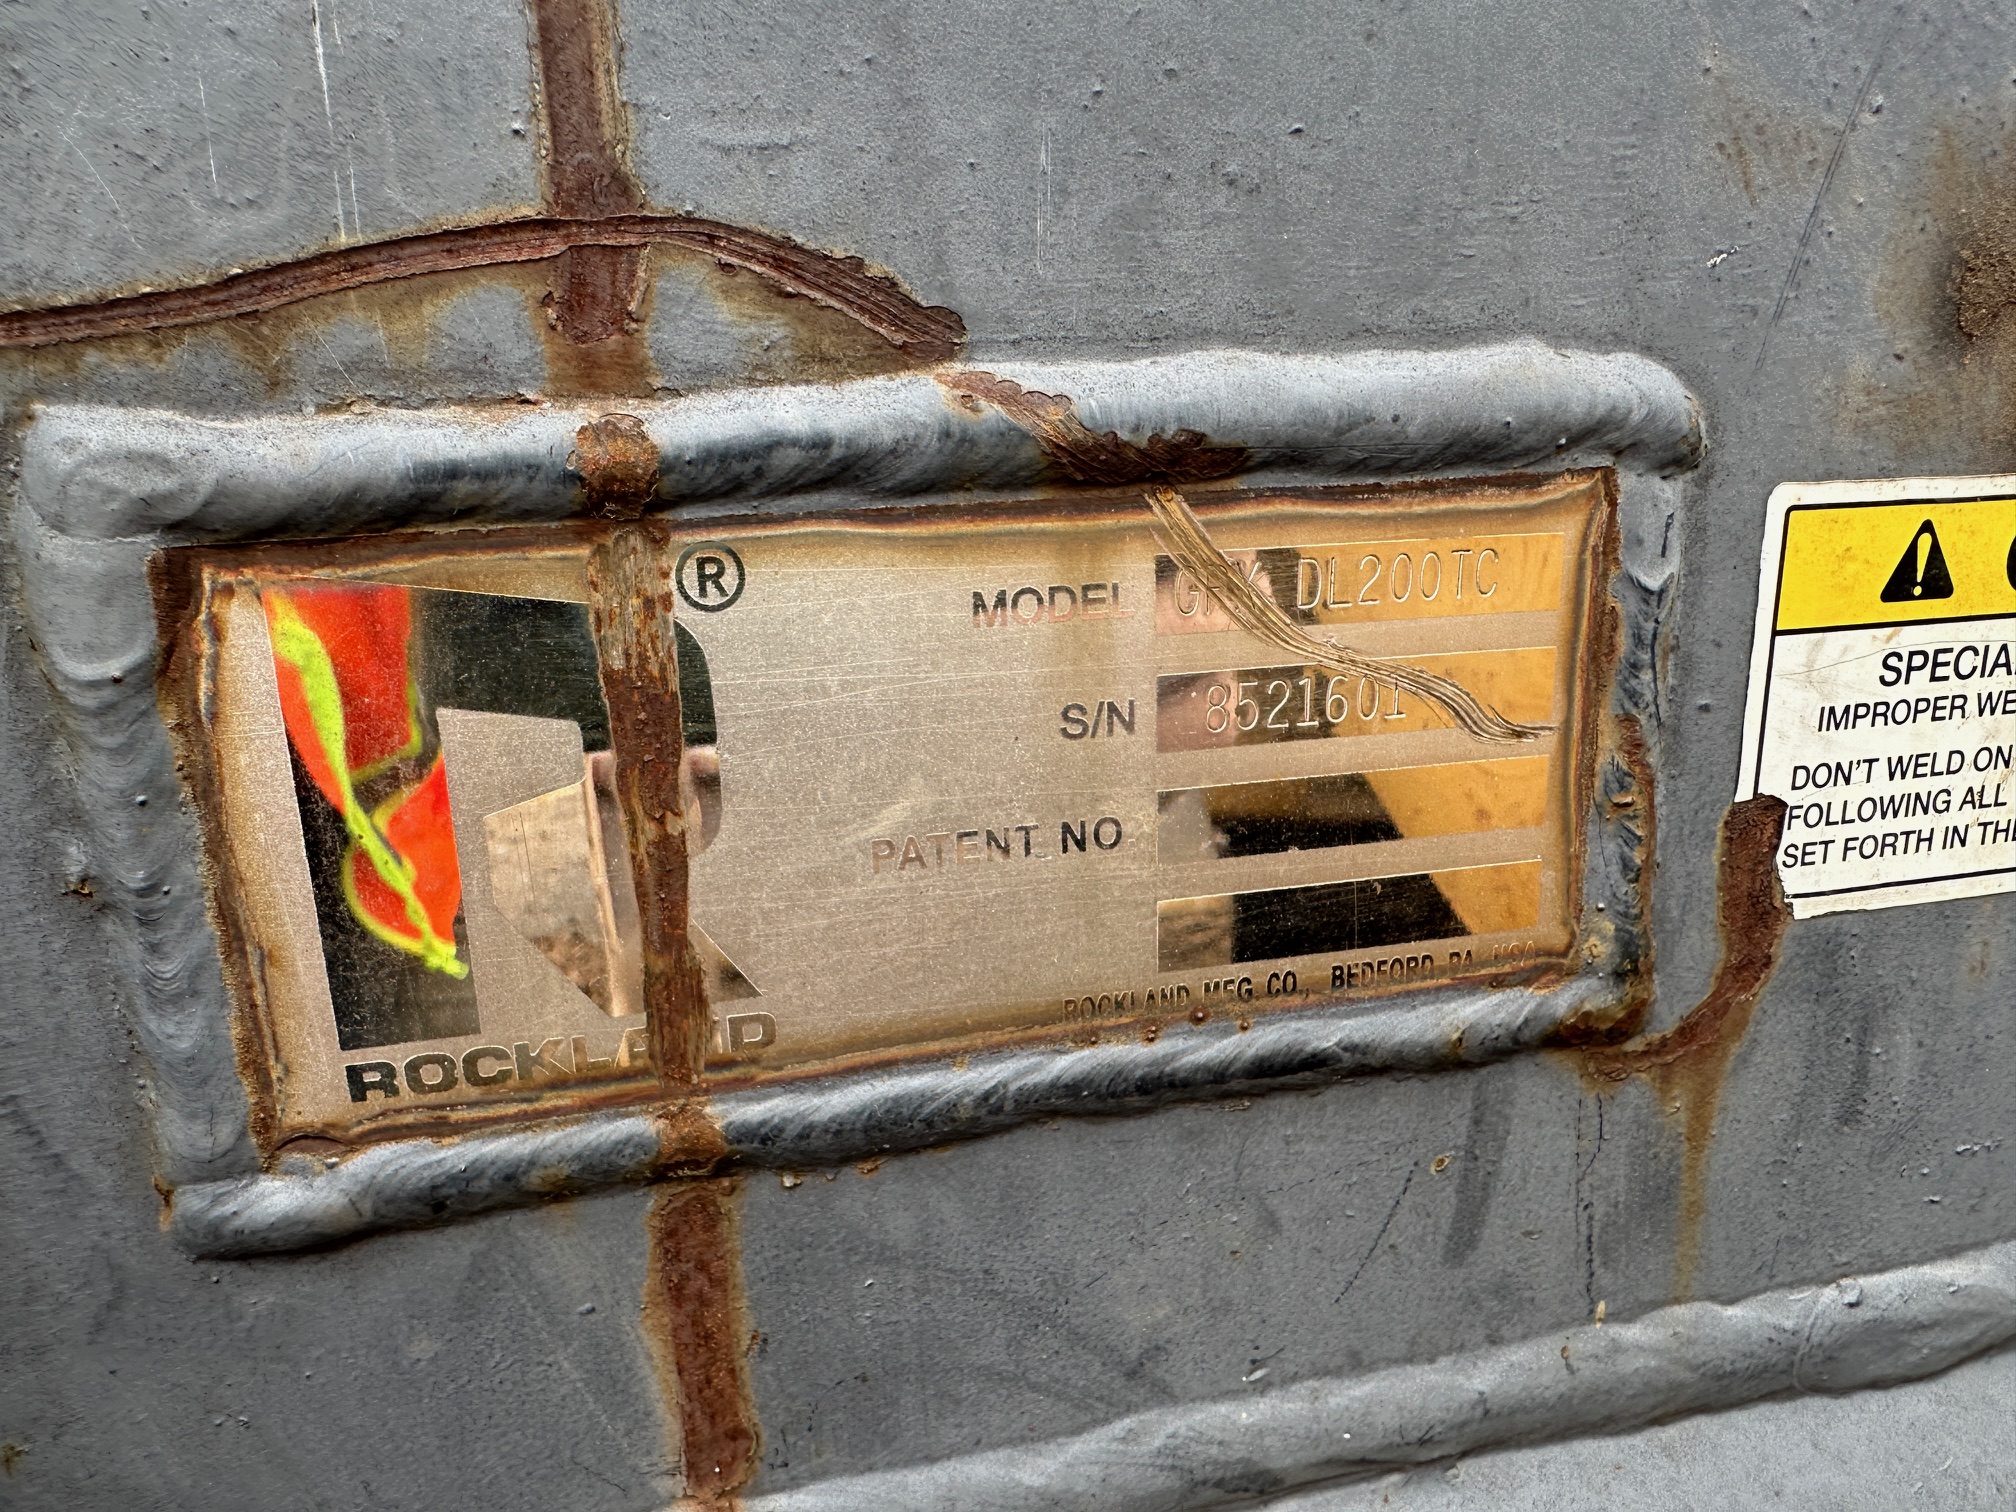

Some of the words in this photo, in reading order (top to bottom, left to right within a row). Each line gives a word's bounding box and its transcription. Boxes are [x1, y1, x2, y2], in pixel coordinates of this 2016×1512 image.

[972, 582, 1135, 628] MODEL
[1297, 548, 1499, 609] DL200TC
[1879, 643, 2016, 686] SPECIA
[1060, 699, 1135, 740] S/N
[1205, 674, 1407, 734] 8521601
[1818, 694, 1968, 732] IMPROPER
[1791, 758, 1879, 790] DON'T
[1887, 750, 1965, 781] WELD
[1973, 744, 2013, 772] ON
[1787, 788, 1951, 830] FOLLOWING
[1958, 783, 2008, 811] ALL
[871, 824, 1039, 874] PATENT
[1782, 839, 1835, 868] SET
[1842, 828, 1934, 861] FORTH
[1942, 824, 1969, 850] IN
[1977, 819, 2016, 845] TH
[1331, 952, 1434, 990] BEDFORD
